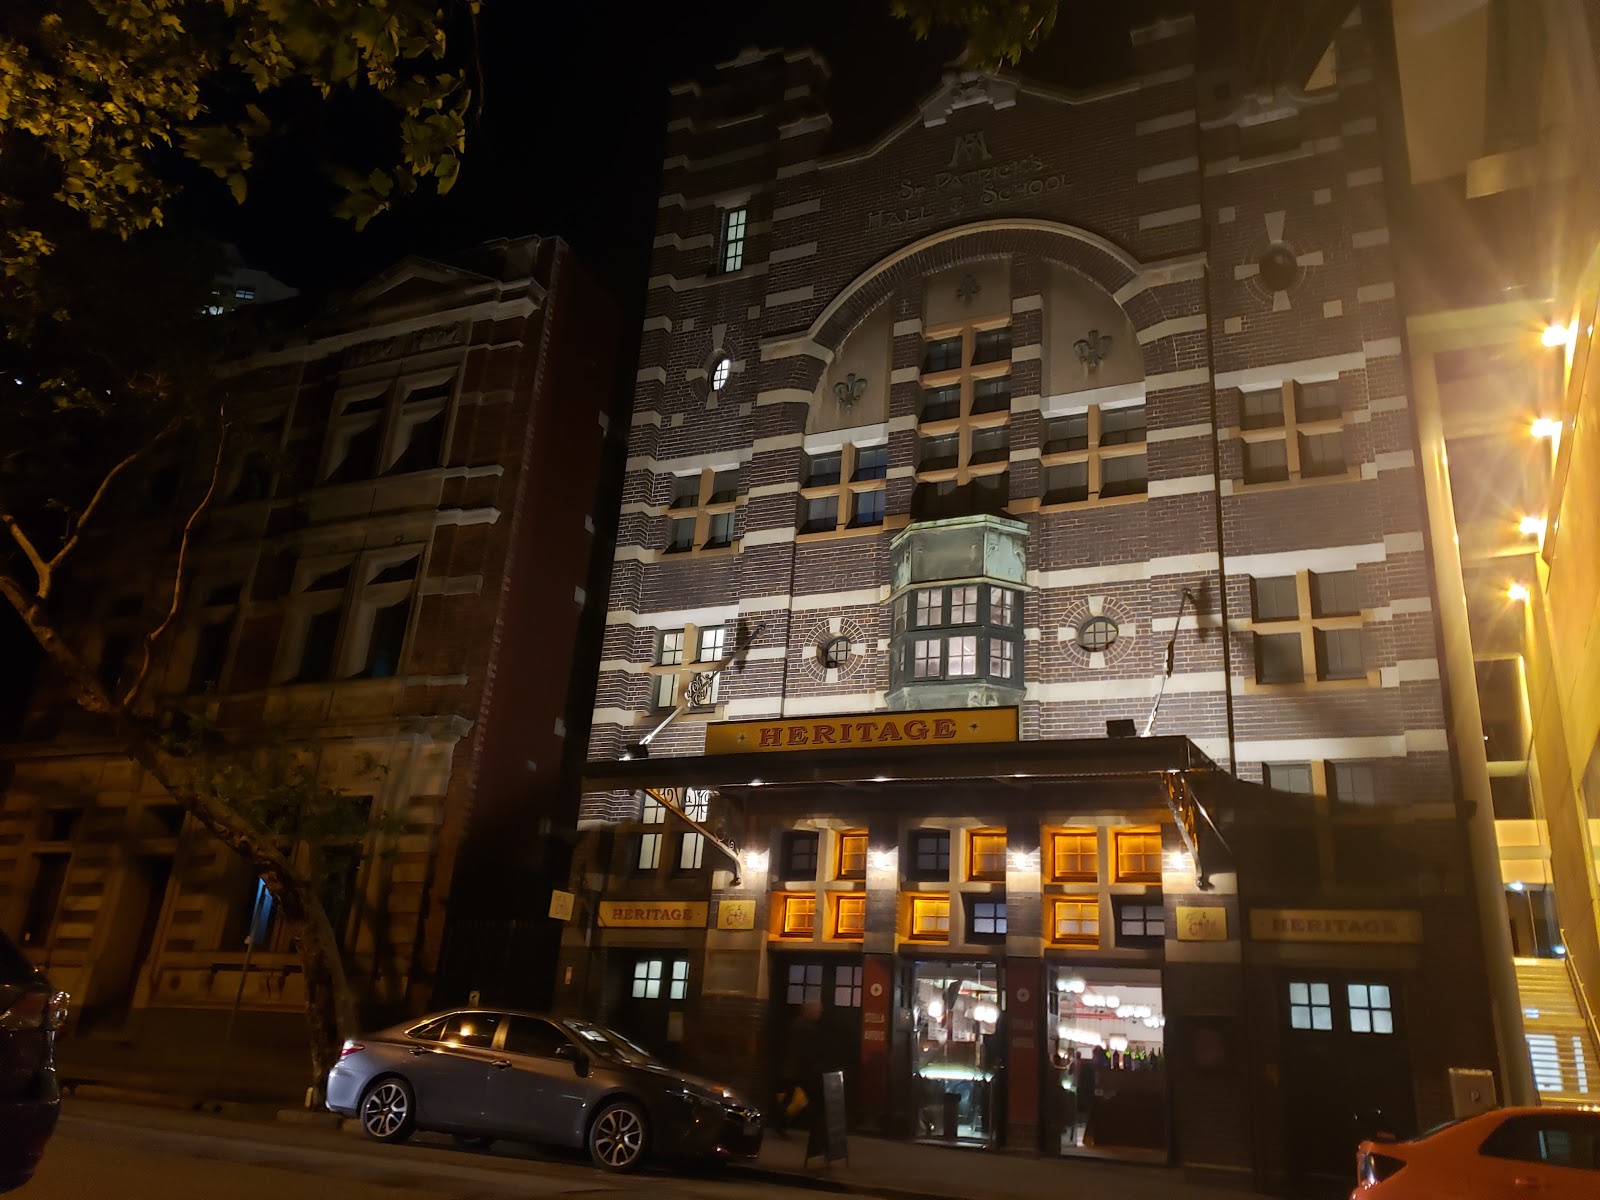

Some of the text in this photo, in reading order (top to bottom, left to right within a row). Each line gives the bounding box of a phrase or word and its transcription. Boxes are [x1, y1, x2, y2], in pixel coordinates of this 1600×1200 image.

[863, 206, 933, 232] HALL
[981, 175, 1073, 205] SCHOOL
[759, 718, 956, 746] HERITAGE
[612, 908, 693, 921] HERITAGE
[1272, 918, 1397, 935] HERITAGE
